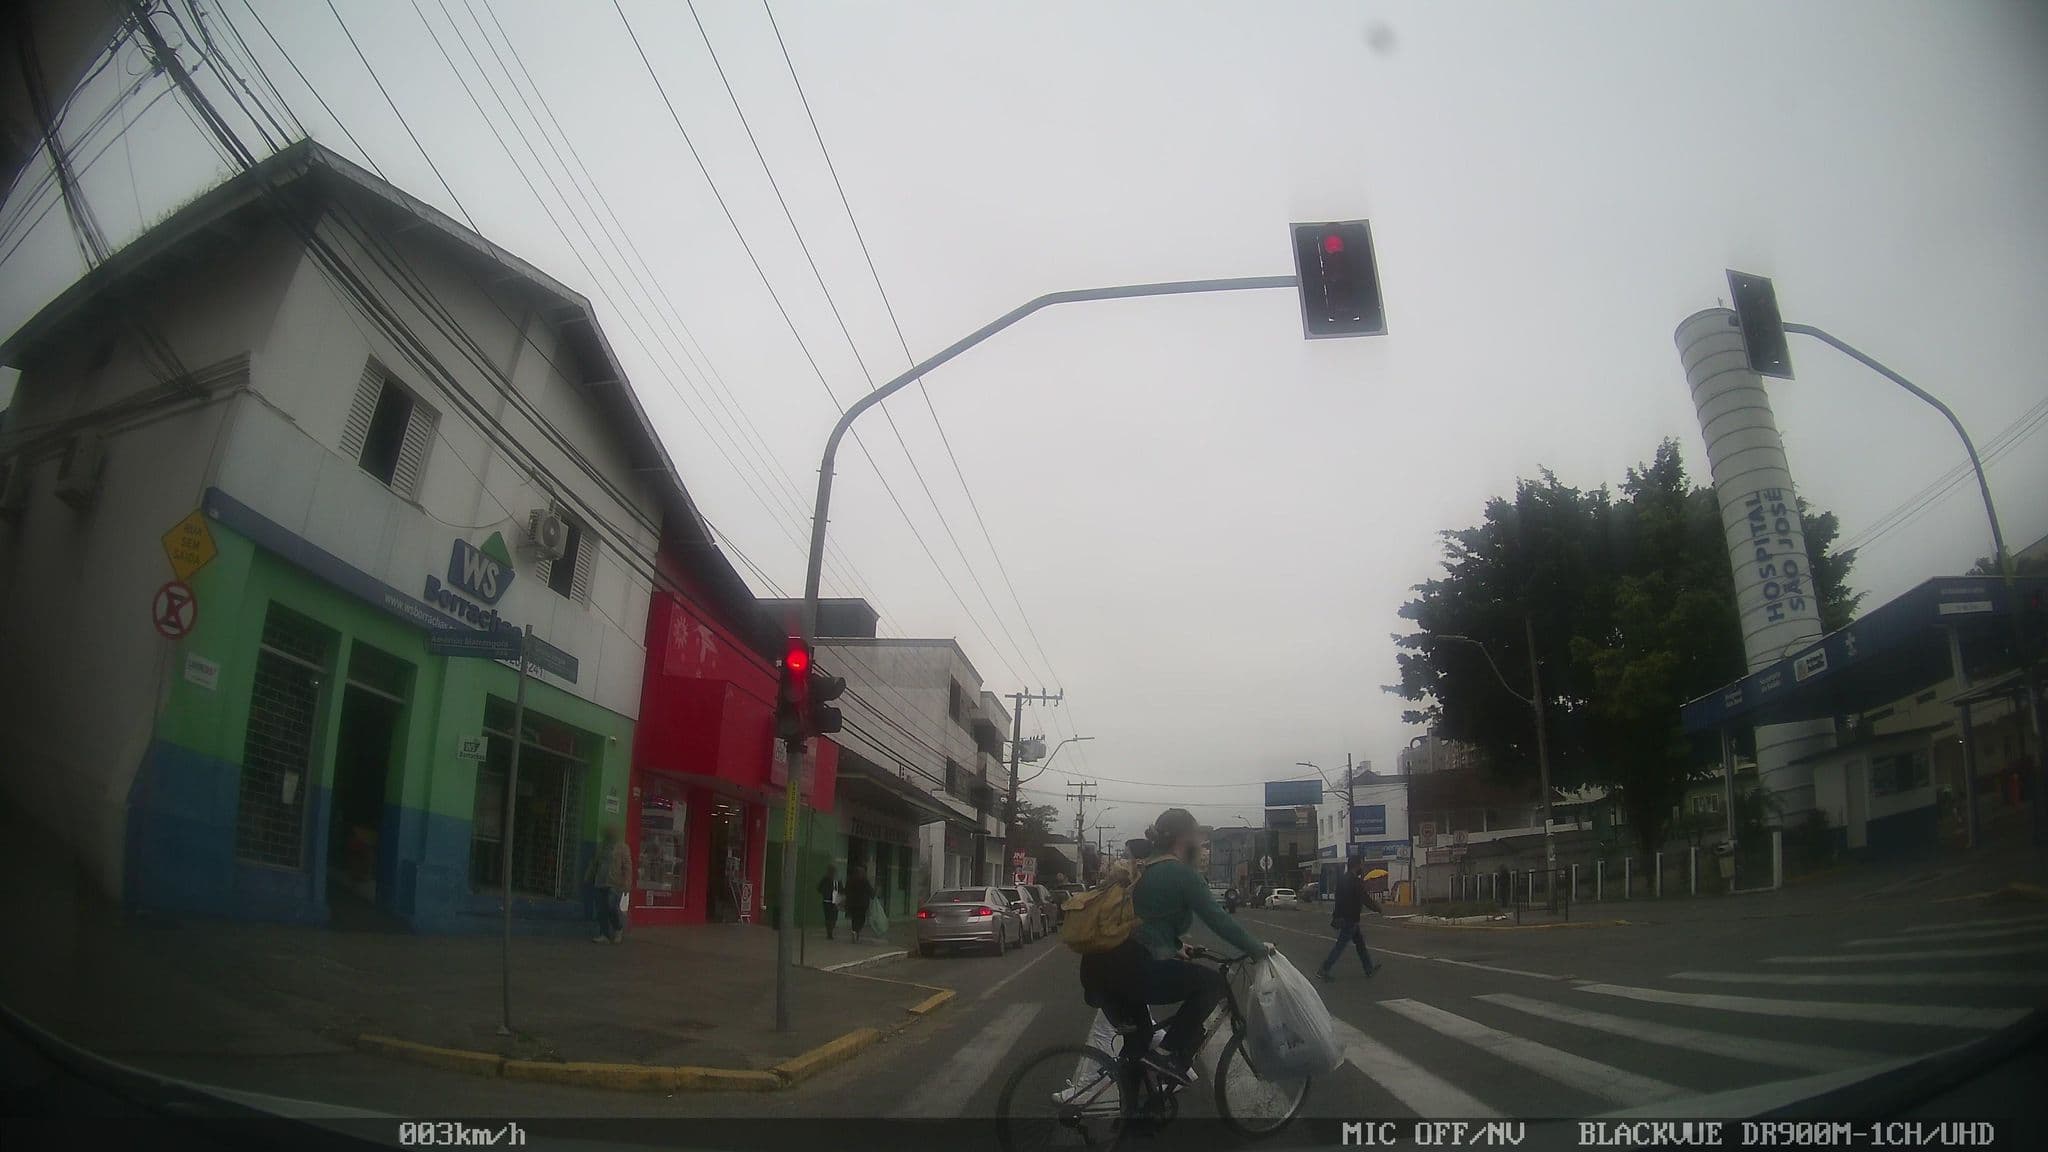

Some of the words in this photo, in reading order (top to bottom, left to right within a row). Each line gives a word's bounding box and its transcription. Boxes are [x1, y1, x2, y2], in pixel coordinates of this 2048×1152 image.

[1764, 487, 1794, 549] JOSÉ
[463, 545, 500, 599] WS
[1744, 489, 1786, 622] HOSPITAL
[1783, 559, 1806, 611] SÃO
